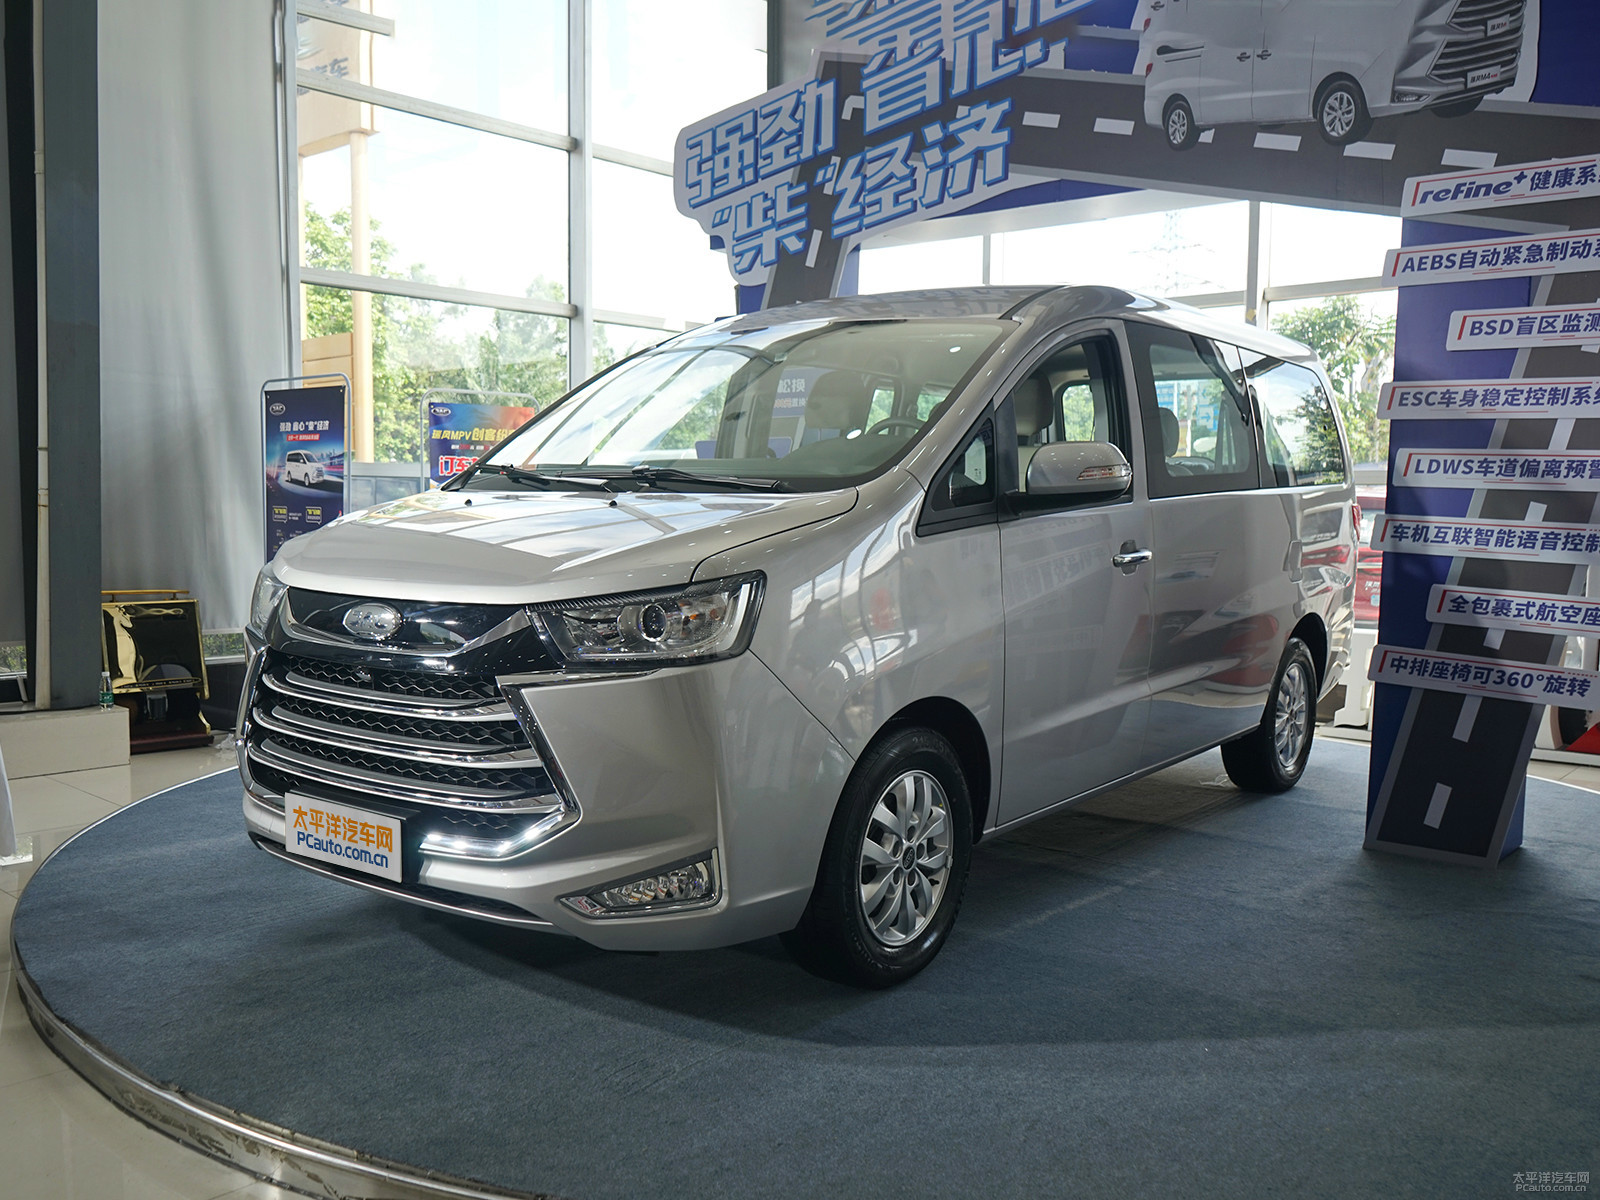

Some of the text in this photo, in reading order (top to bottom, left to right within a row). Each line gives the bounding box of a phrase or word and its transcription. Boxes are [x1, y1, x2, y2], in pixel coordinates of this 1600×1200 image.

[1469, 312, 1600, 337] BSD盲区监测
[439, 456, 478, 476] 订车
[1390, 523, 1600, 554] 车机互联智能语音控制
[1448, 594, 1600, 627] 全包裹式航空座
[1390, 655, 1591, 698] 中排座椅可360°旋转
[292, 805, 393, 852] 太平洋汽车网
[297, 830, 389, 868] PCauto.com.cn
